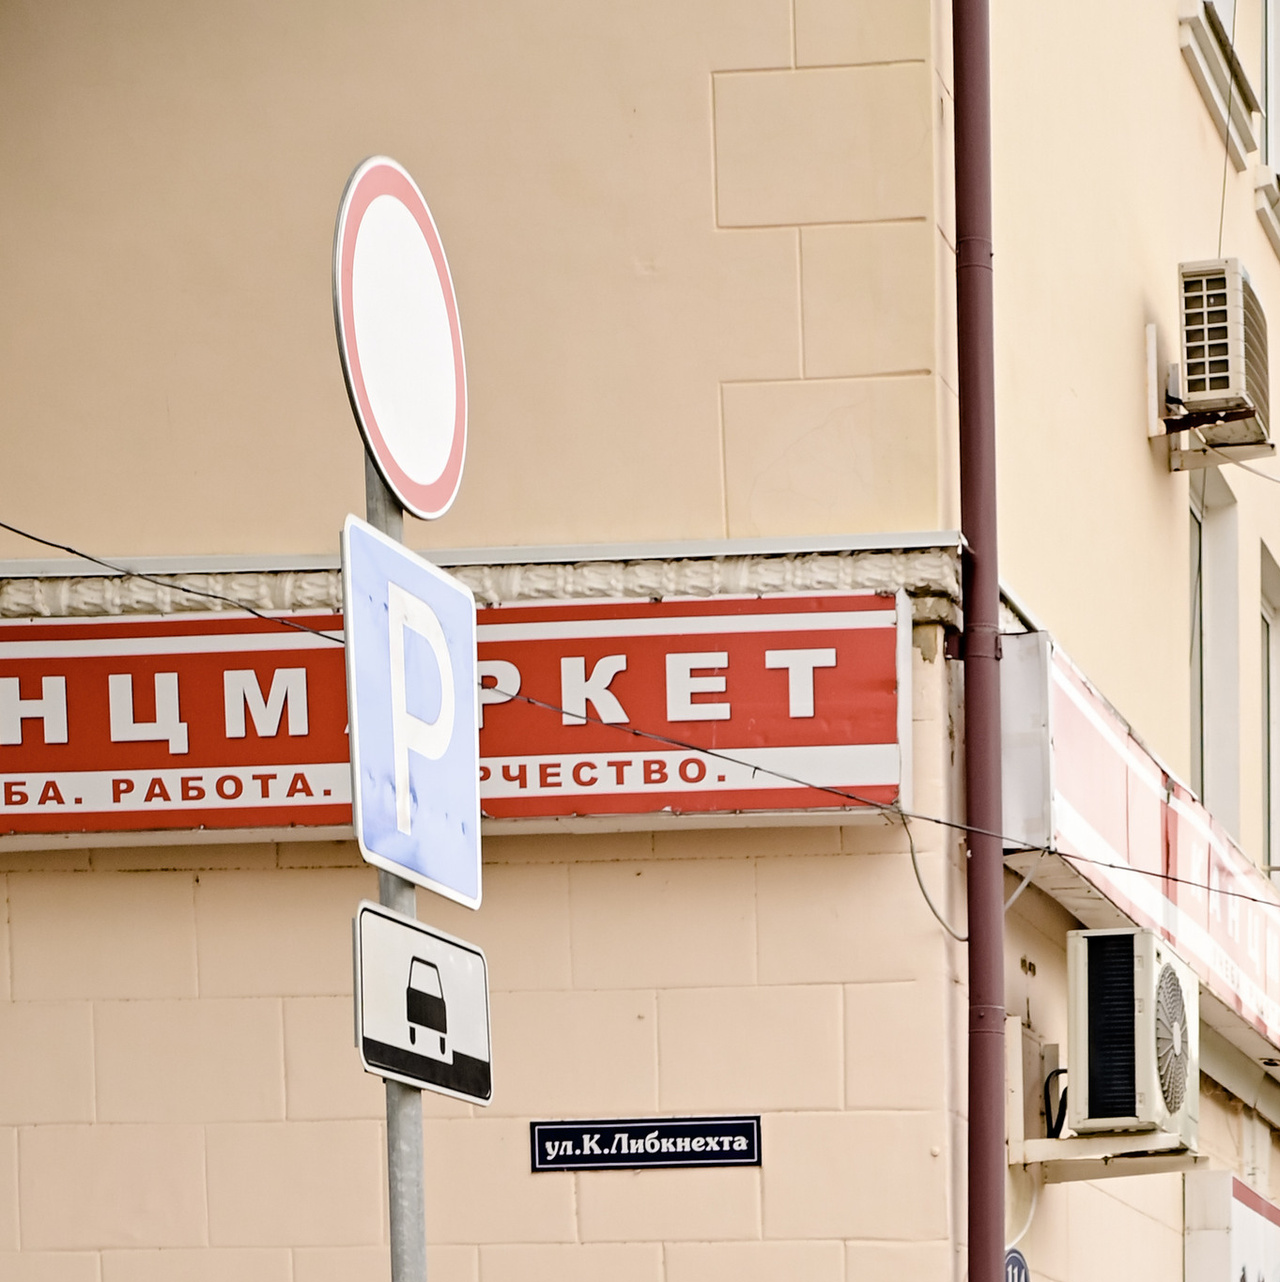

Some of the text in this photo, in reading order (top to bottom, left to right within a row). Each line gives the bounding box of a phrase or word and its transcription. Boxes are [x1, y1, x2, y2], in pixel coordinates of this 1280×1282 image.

[0, 648, 837, 755] НЦМРКЕТ
[388, 580, 455, 836] P
[112, 772, 332, 804] РАБОТА.
[479, 757, 726, 790] ЧЕСТВО.
[545, 1130, 748, 1160] ул.К.Либкнехта
